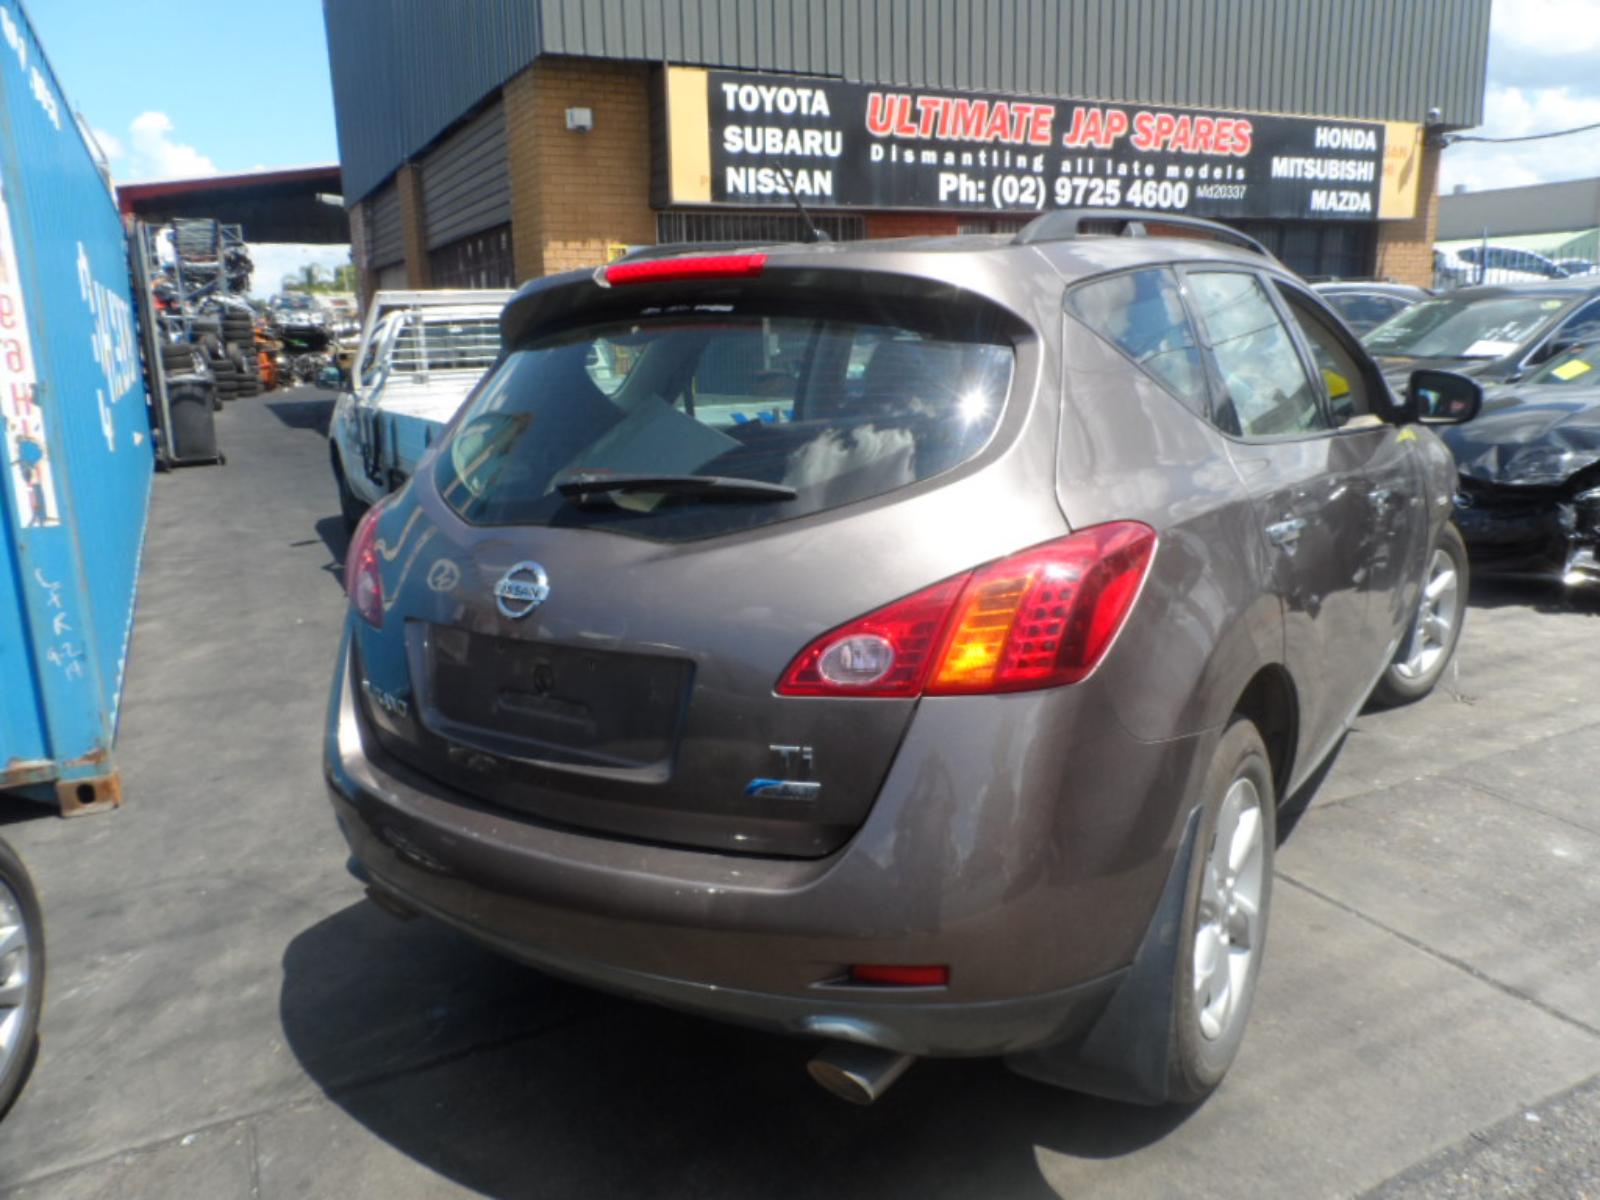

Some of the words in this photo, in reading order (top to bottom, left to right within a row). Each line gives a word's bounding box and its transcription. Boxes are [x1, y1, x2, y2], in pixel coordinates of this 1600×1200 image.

[722, 83, 831, 117] TOYOTA
[866, 92, 1056, 146] ULTIMATE
[1062, 106, 1128, 150] JAP
[1131, 111, 1253, 157] SPARES
[1315, 127, 1377, 151] HONDA
[723, 125, 843, 158] SUBARU
[870, 144, 1044, 172] Dismantling
[1061, 158, 1093, 175] all
[1106, 158, 1153, 177] late
[1165, 160, 1246, 180] models
[1271, 157, 1375, 182] MITSUBISHI
[726, 166, 833, 196] NISSAN
[938, 172, 986, 203] Ph:
[991, 174, 1047, 210] (02)
[1055, 177, 1121, 208] 9725
[1126, 179, 1189, 209] 4600
[1310, 189, 1372, 213] MAZDA
